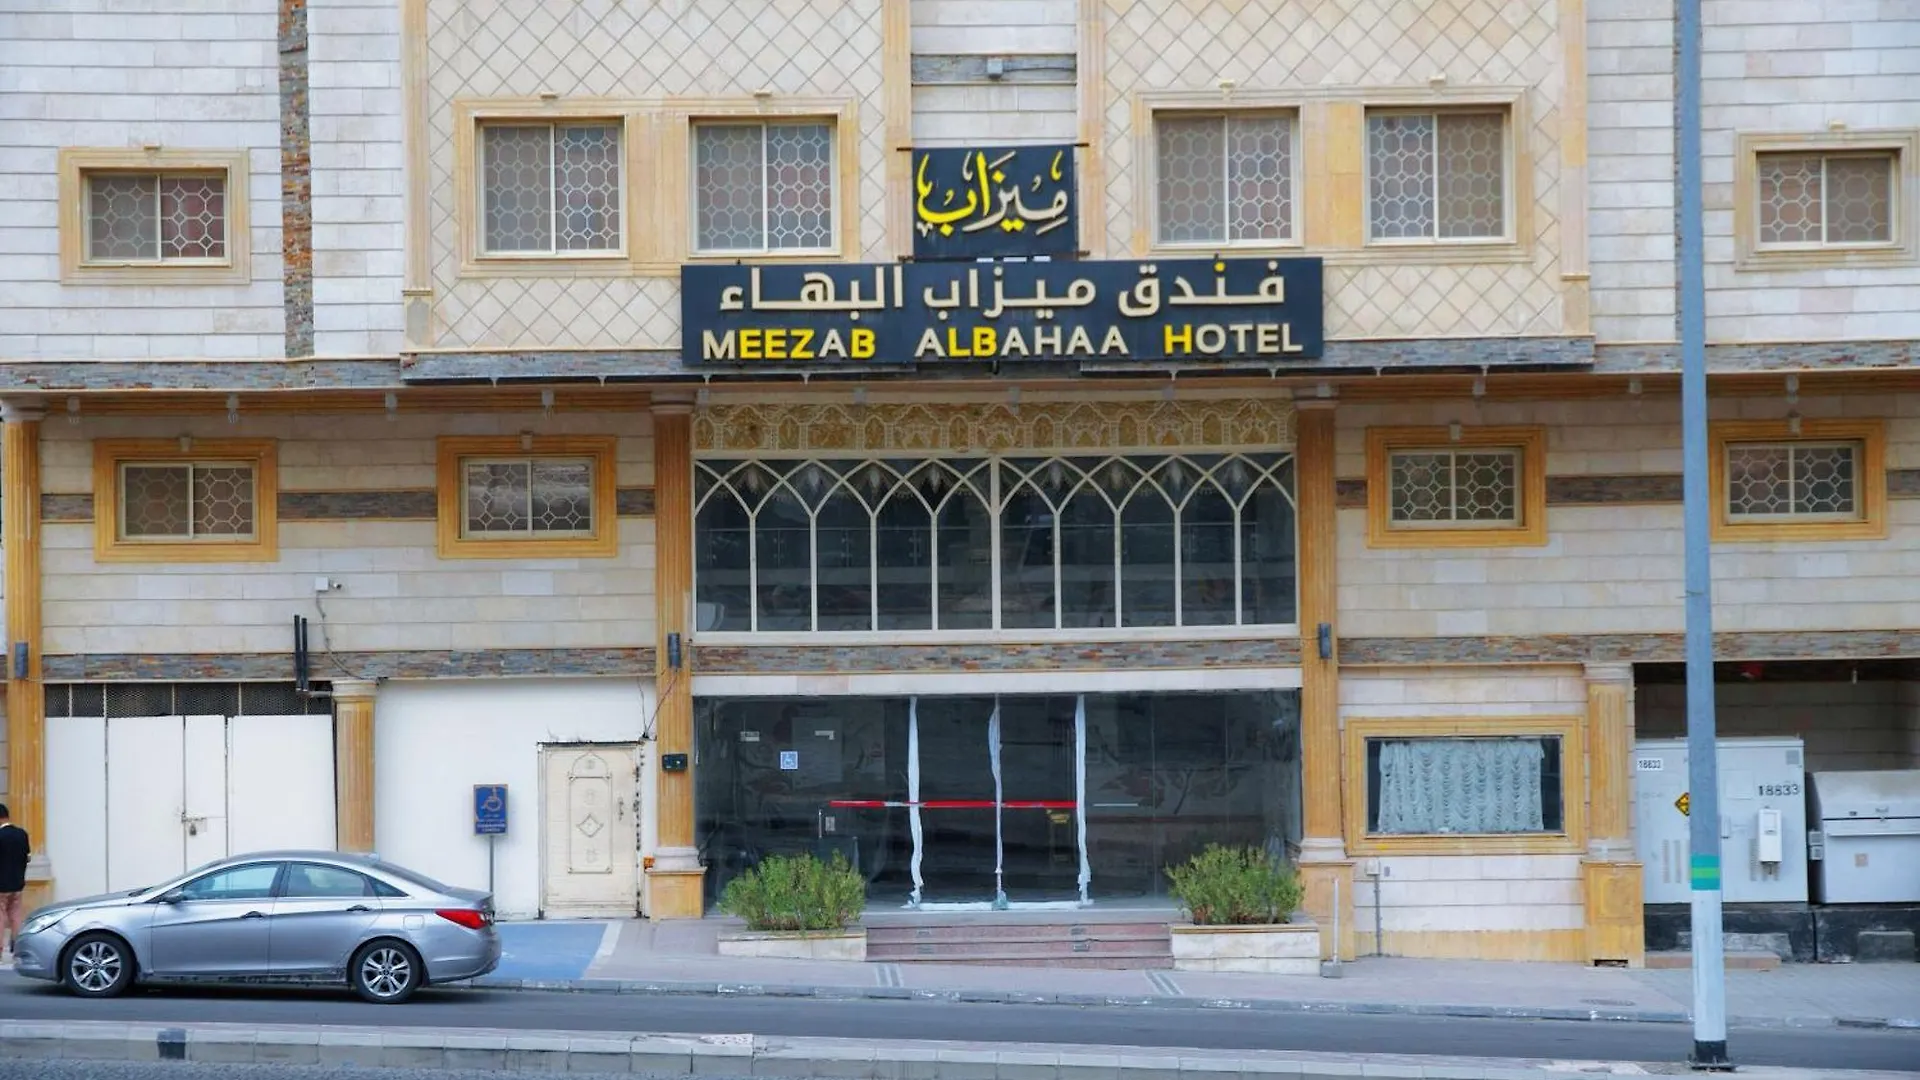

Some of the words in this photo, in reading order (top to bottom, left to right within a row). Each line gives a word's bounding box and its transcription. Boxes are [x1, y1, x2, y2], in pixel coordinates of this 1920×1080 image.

[719, 265, 903, 321] البهاء
[923, 266, 1097, 321] ميزاب
[1118, 260, 1285, 317] فندق
[702, 328, 876, 360] MEEZAB
[914, 324, 1130, 357] ALBAHAA
[1163, 322, 1304, 354] HOTEL
